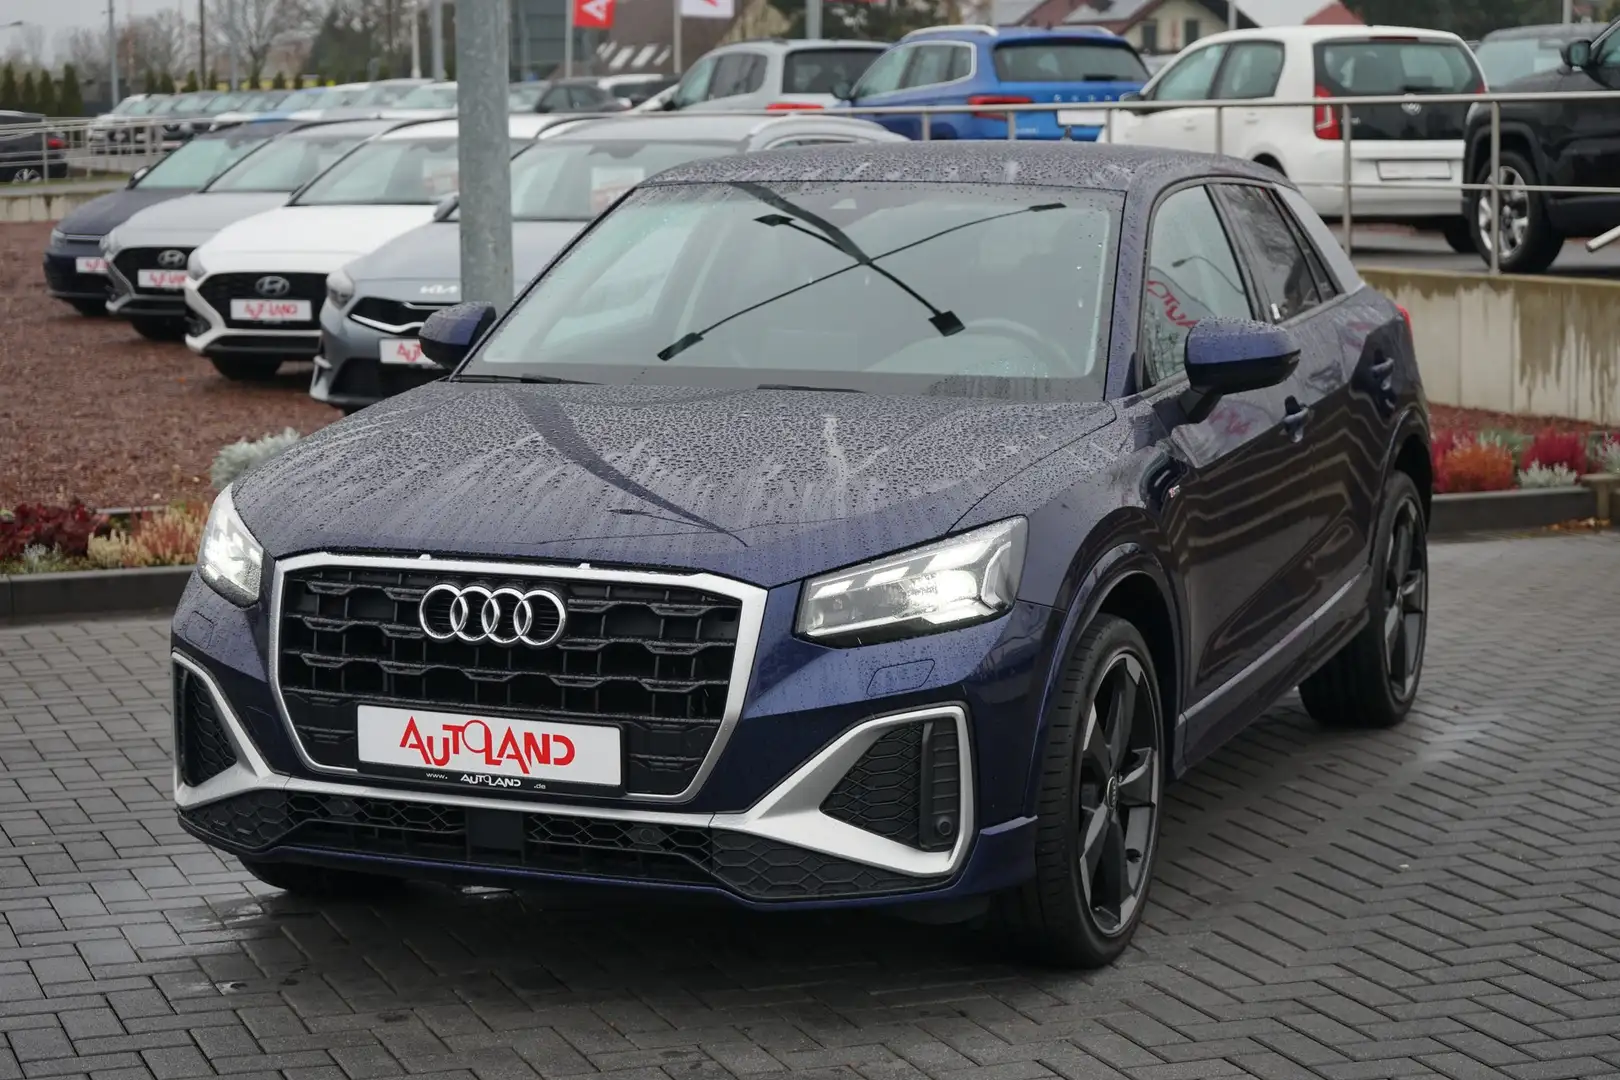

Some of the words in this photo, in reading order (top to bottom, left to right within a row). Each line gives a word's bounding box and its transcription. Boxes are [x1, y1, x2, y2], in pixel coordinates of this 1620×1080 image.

[400, 716, 576, 775] AUTOLAND
[426, 772, 448, 780] www.
[460, 774, 522, 788] AUTOLAND
